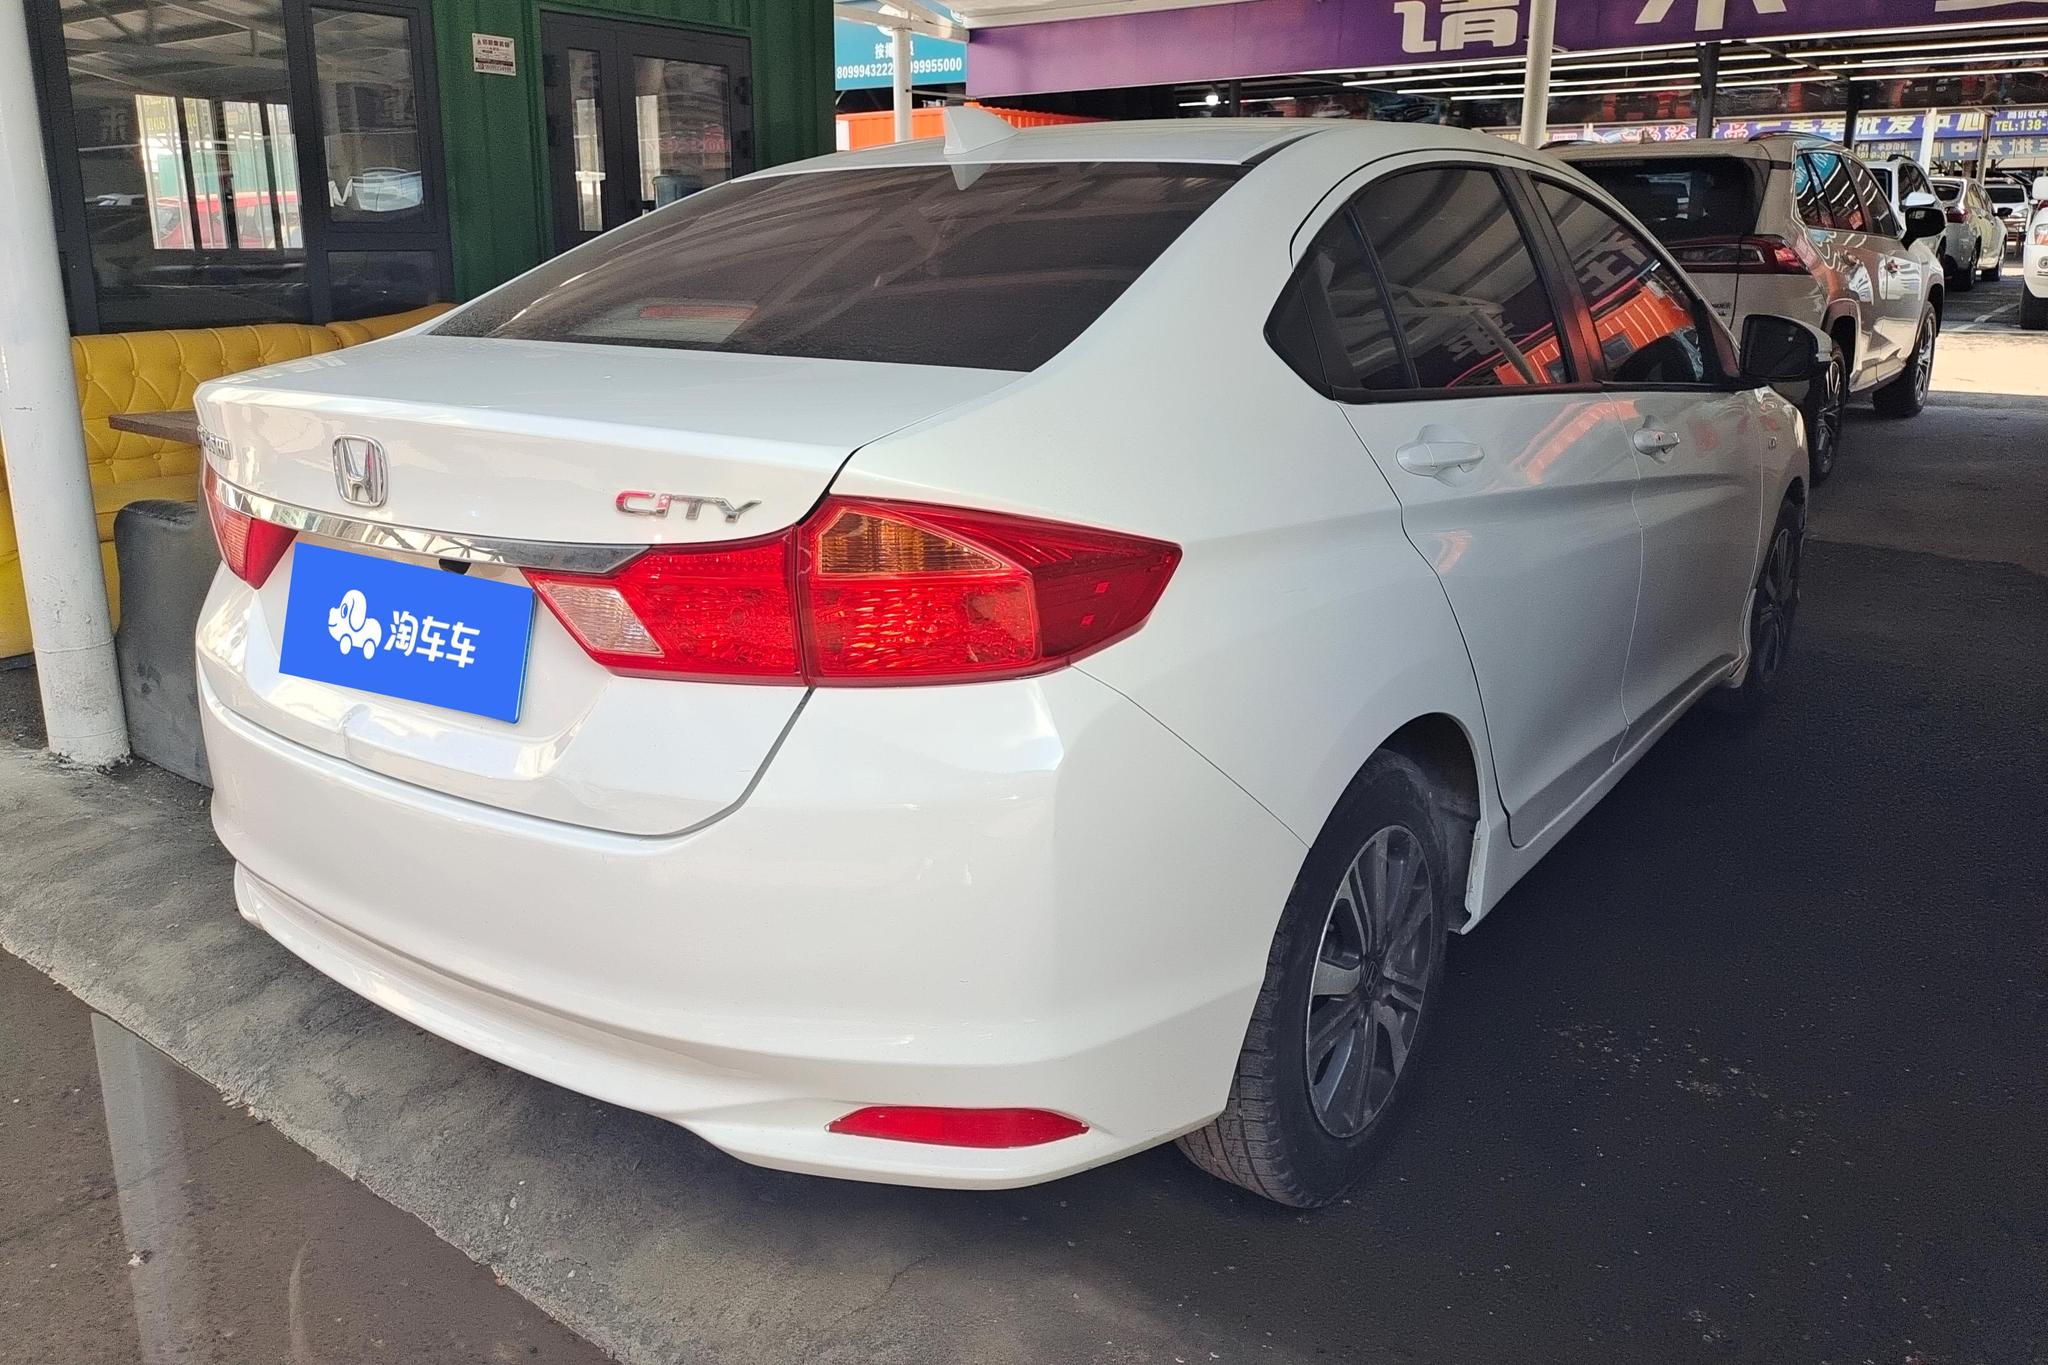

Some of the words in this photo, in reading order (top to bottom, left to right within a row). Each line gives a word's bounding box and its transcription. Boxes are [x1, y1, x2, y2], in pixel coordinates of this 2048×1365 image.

[909, 57, 963, 74] 99955000
[1995, 118, 2048, 132] TEL:138-
[615, 490, 762, 523] CITY
